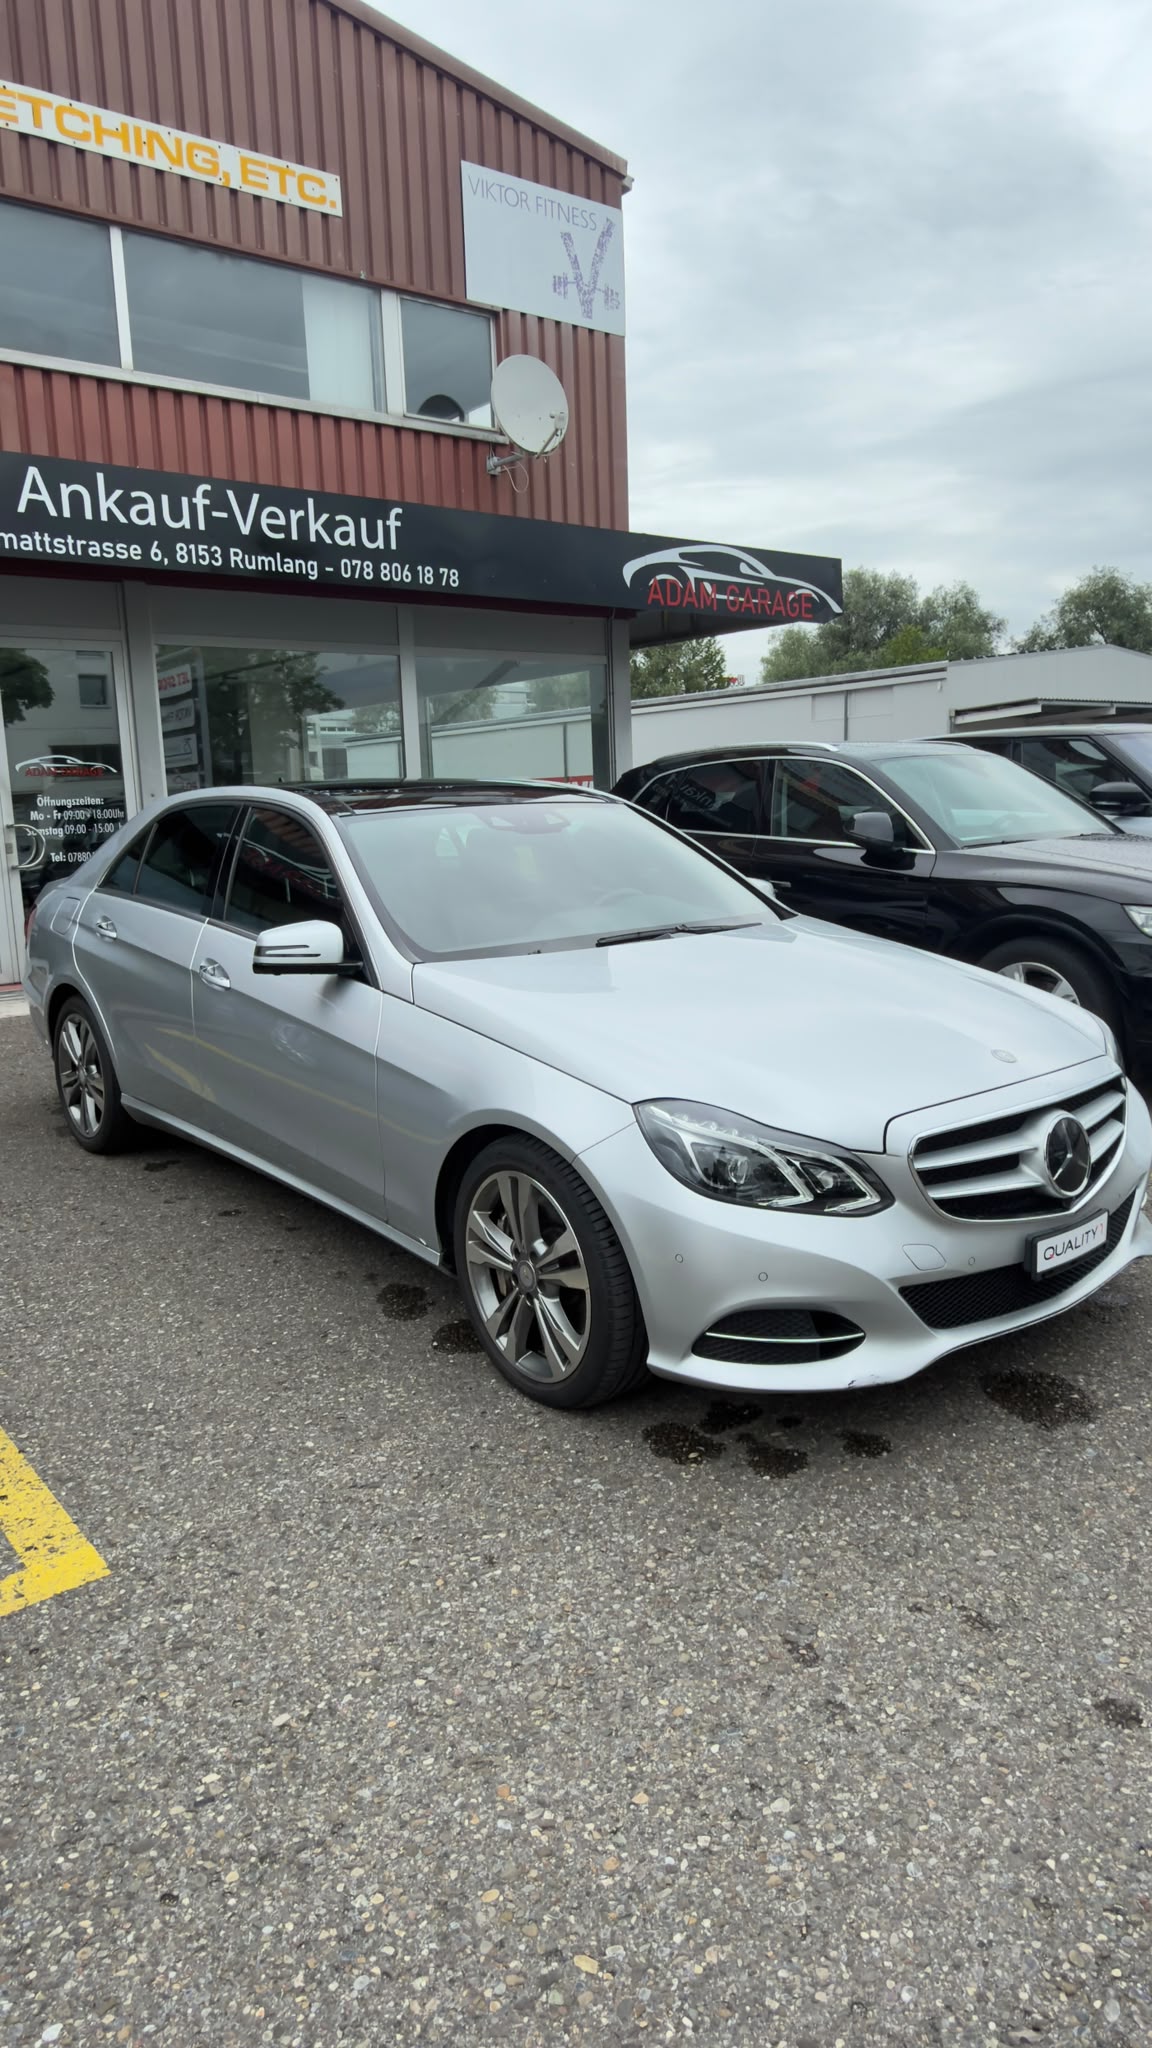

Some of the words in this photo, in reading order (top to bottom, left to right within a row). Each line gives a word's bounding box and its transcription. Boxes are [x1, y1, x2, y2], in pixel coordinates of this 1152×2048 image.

[468, 175, 530, 212] VIKTOR
[535, 196, 598, 231] FITNESS
[17, 465, 403, 550] Ankauf-Verkauf
[150, 540, 168, 566] 6,
[175, 542, 222, 567] 8153
[229, 547, 318, 580] Rumlang
[340, 558, 374, 580] 078
[380, 562, 412, 583] 806
[417, 565, 434, 584] 18
[440, 568, 460, 588] 78
[647, 577, 717, 612] ADAM
[726, 584, 813, 619] GARAGE
[30, 810, 45, 820] Mo
[53, 810, 61, 820] Fr
[64, 824, 86, 835] 09:00
